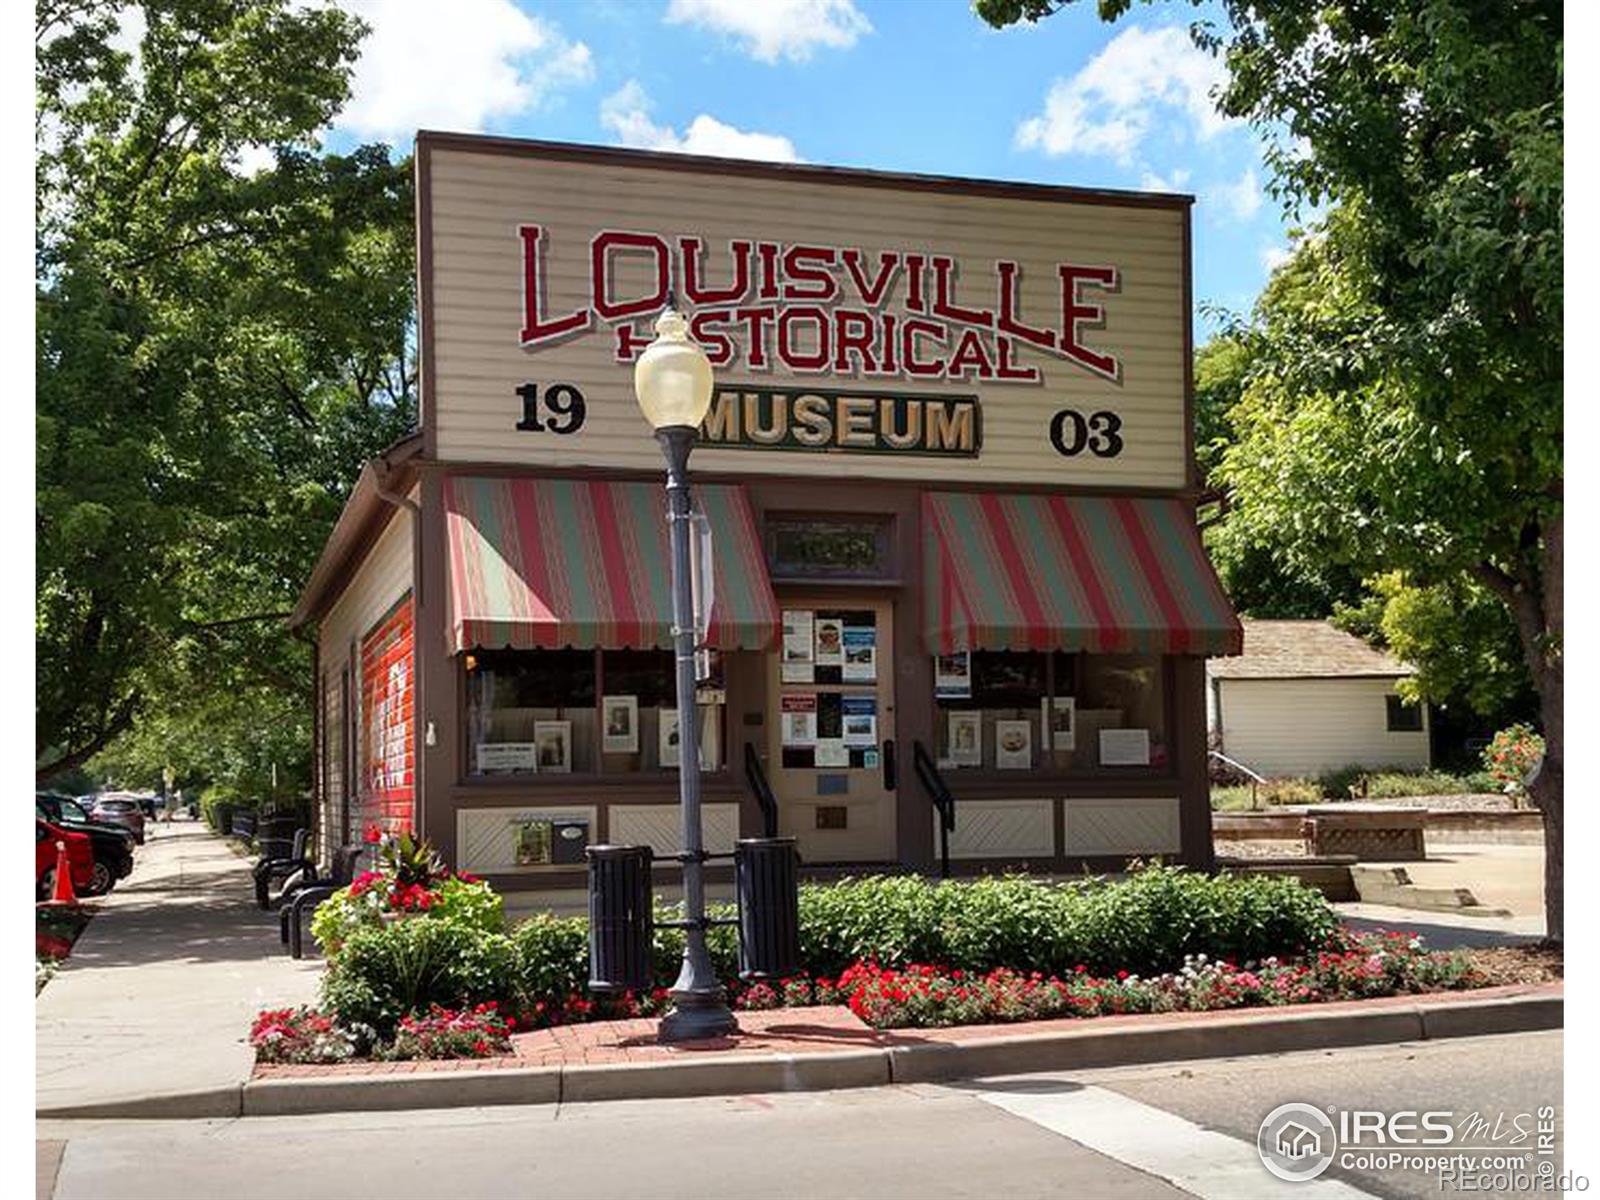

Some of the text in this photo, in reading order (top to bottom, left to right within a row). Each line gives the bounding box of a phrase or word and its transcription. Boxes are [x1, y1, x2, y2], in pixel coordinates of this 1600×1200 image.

[518, 224, 1121, 379] LOUISVILLE
[614, 306, 1041, 381] HSTORICAL
[515, 382, 587, 435] 19
[700, 392, 974, 451] MUSEUM
[1049, 409, 1124, 458] 03
